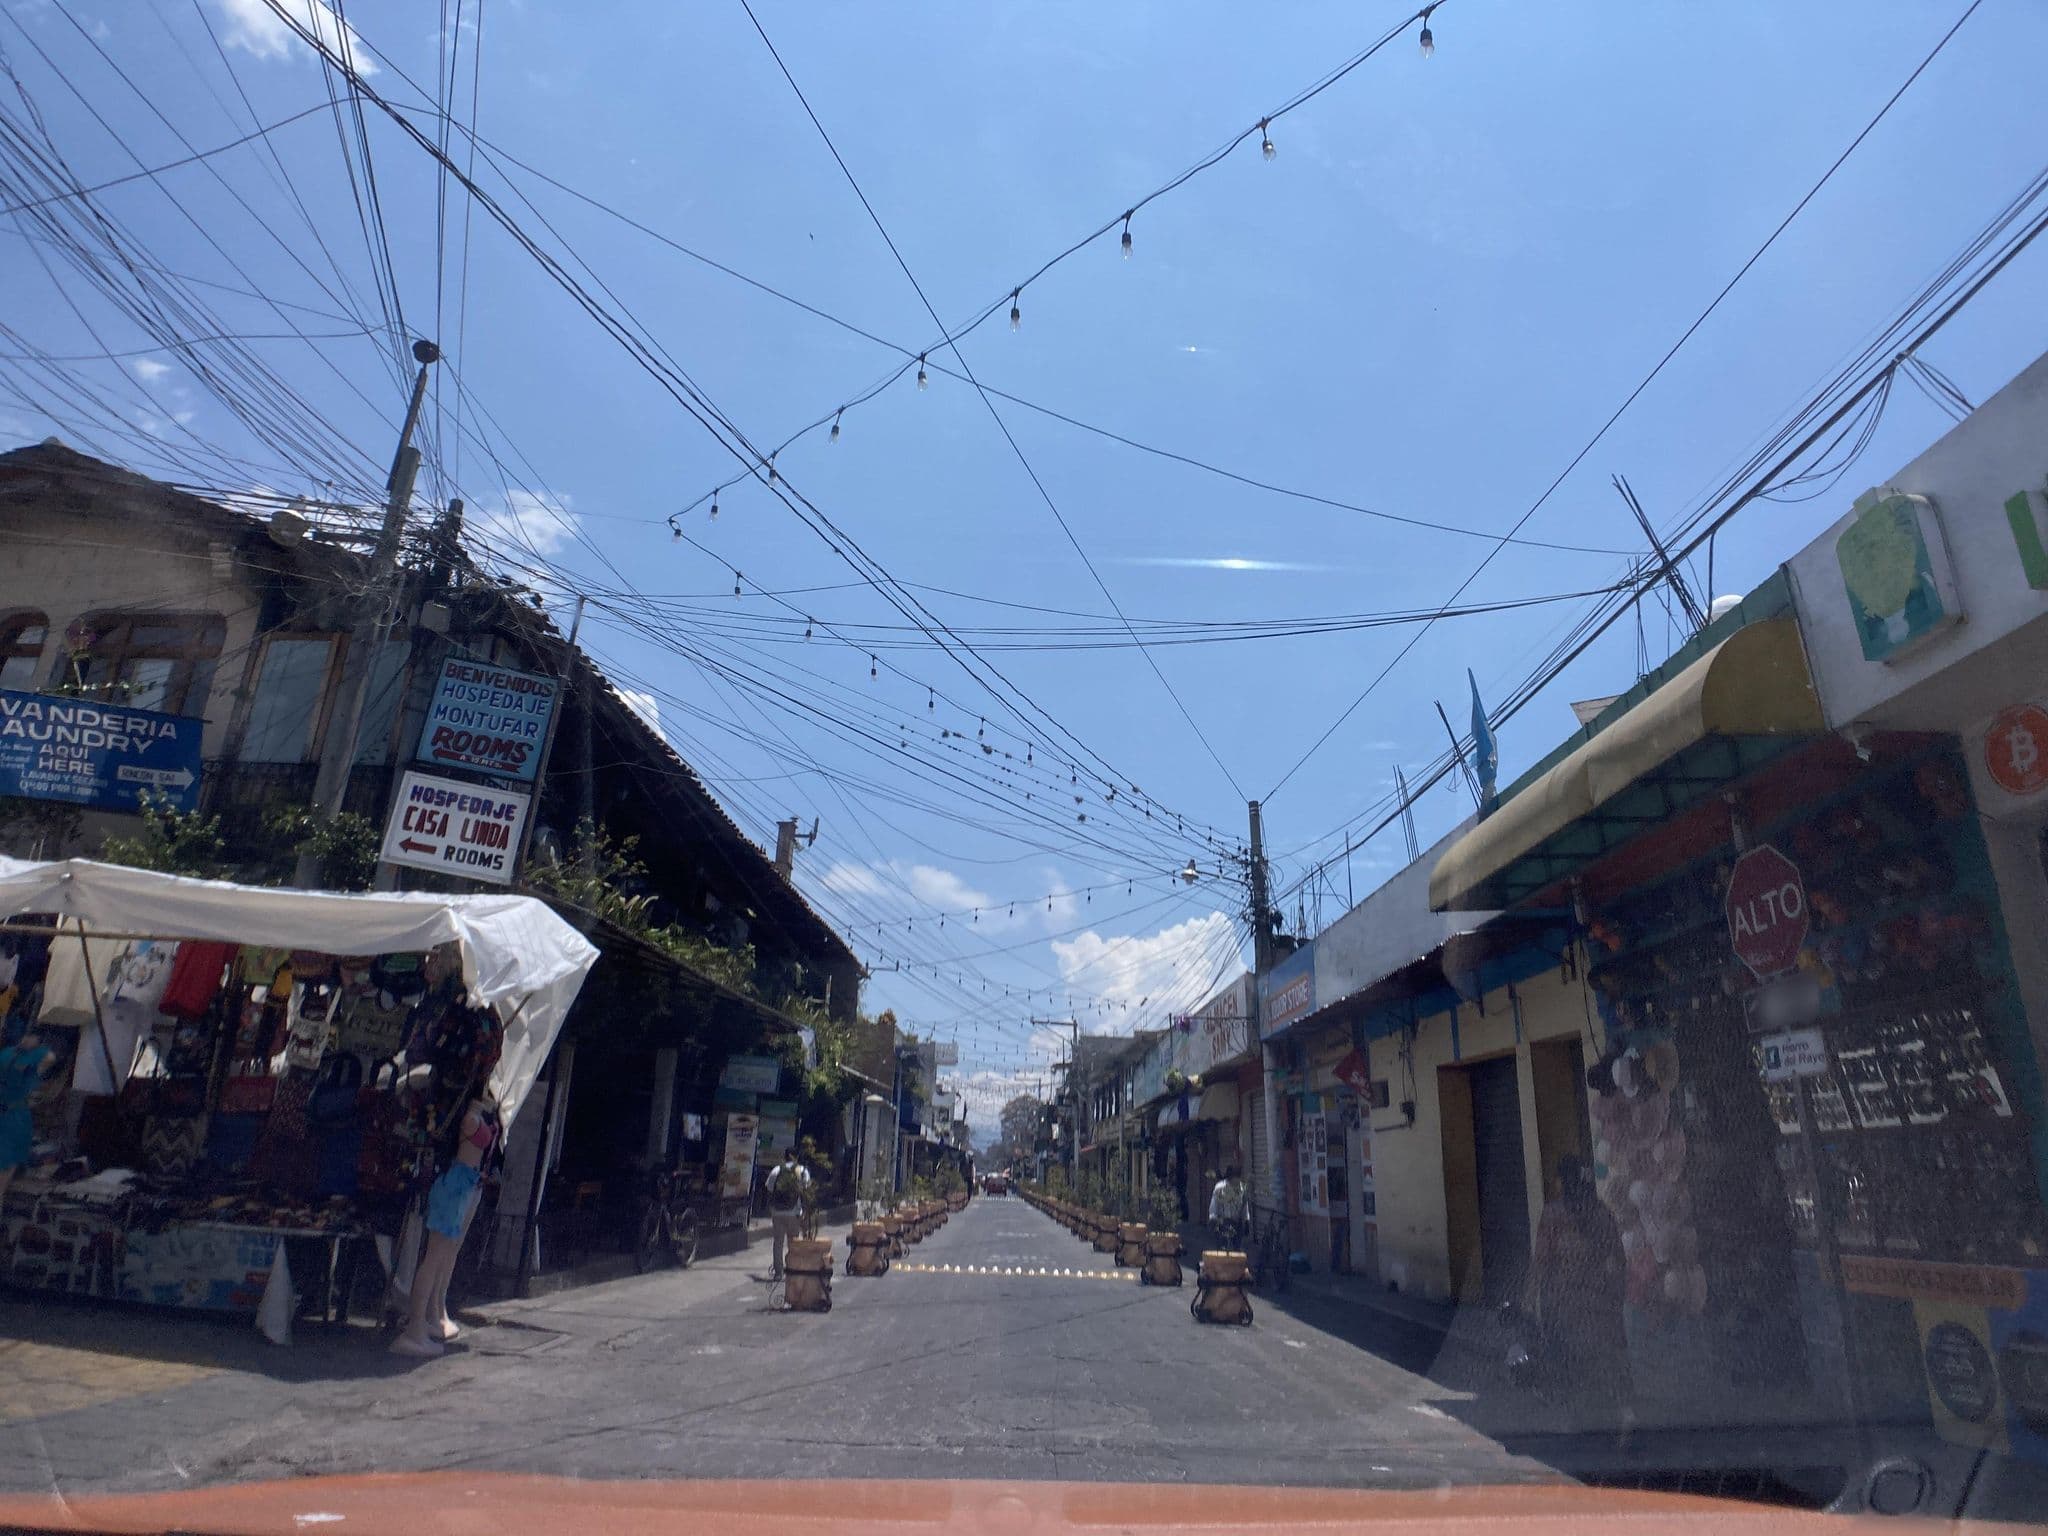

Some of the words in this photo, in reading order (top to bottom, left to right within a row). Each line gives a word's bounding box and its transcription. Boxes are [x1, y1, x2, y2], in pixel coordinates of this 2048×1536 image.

[442, 681, 549, 716] HOSPEDAJE
[444, 662, 553, 699] BIENVENIDOS
[0, 699, 177, 740] VANDERIA
[2, 719, 154, 754] AUNDRY
[434, 703, 540, 738] MONTUFAR
[39, 743, 89, 761] AQUI
[431, 726, 534, 764] ROOMS
[38, 758, 95, 775] HERE
[410, 784, 518, 822] HOSPEDAJE
[402, 805, 450, 838] CASA
[460, 817, 511, 850] LINDA
[443, 844, 505, 870] ROOMS
[1734, 882, 1803, 942] ALTO
